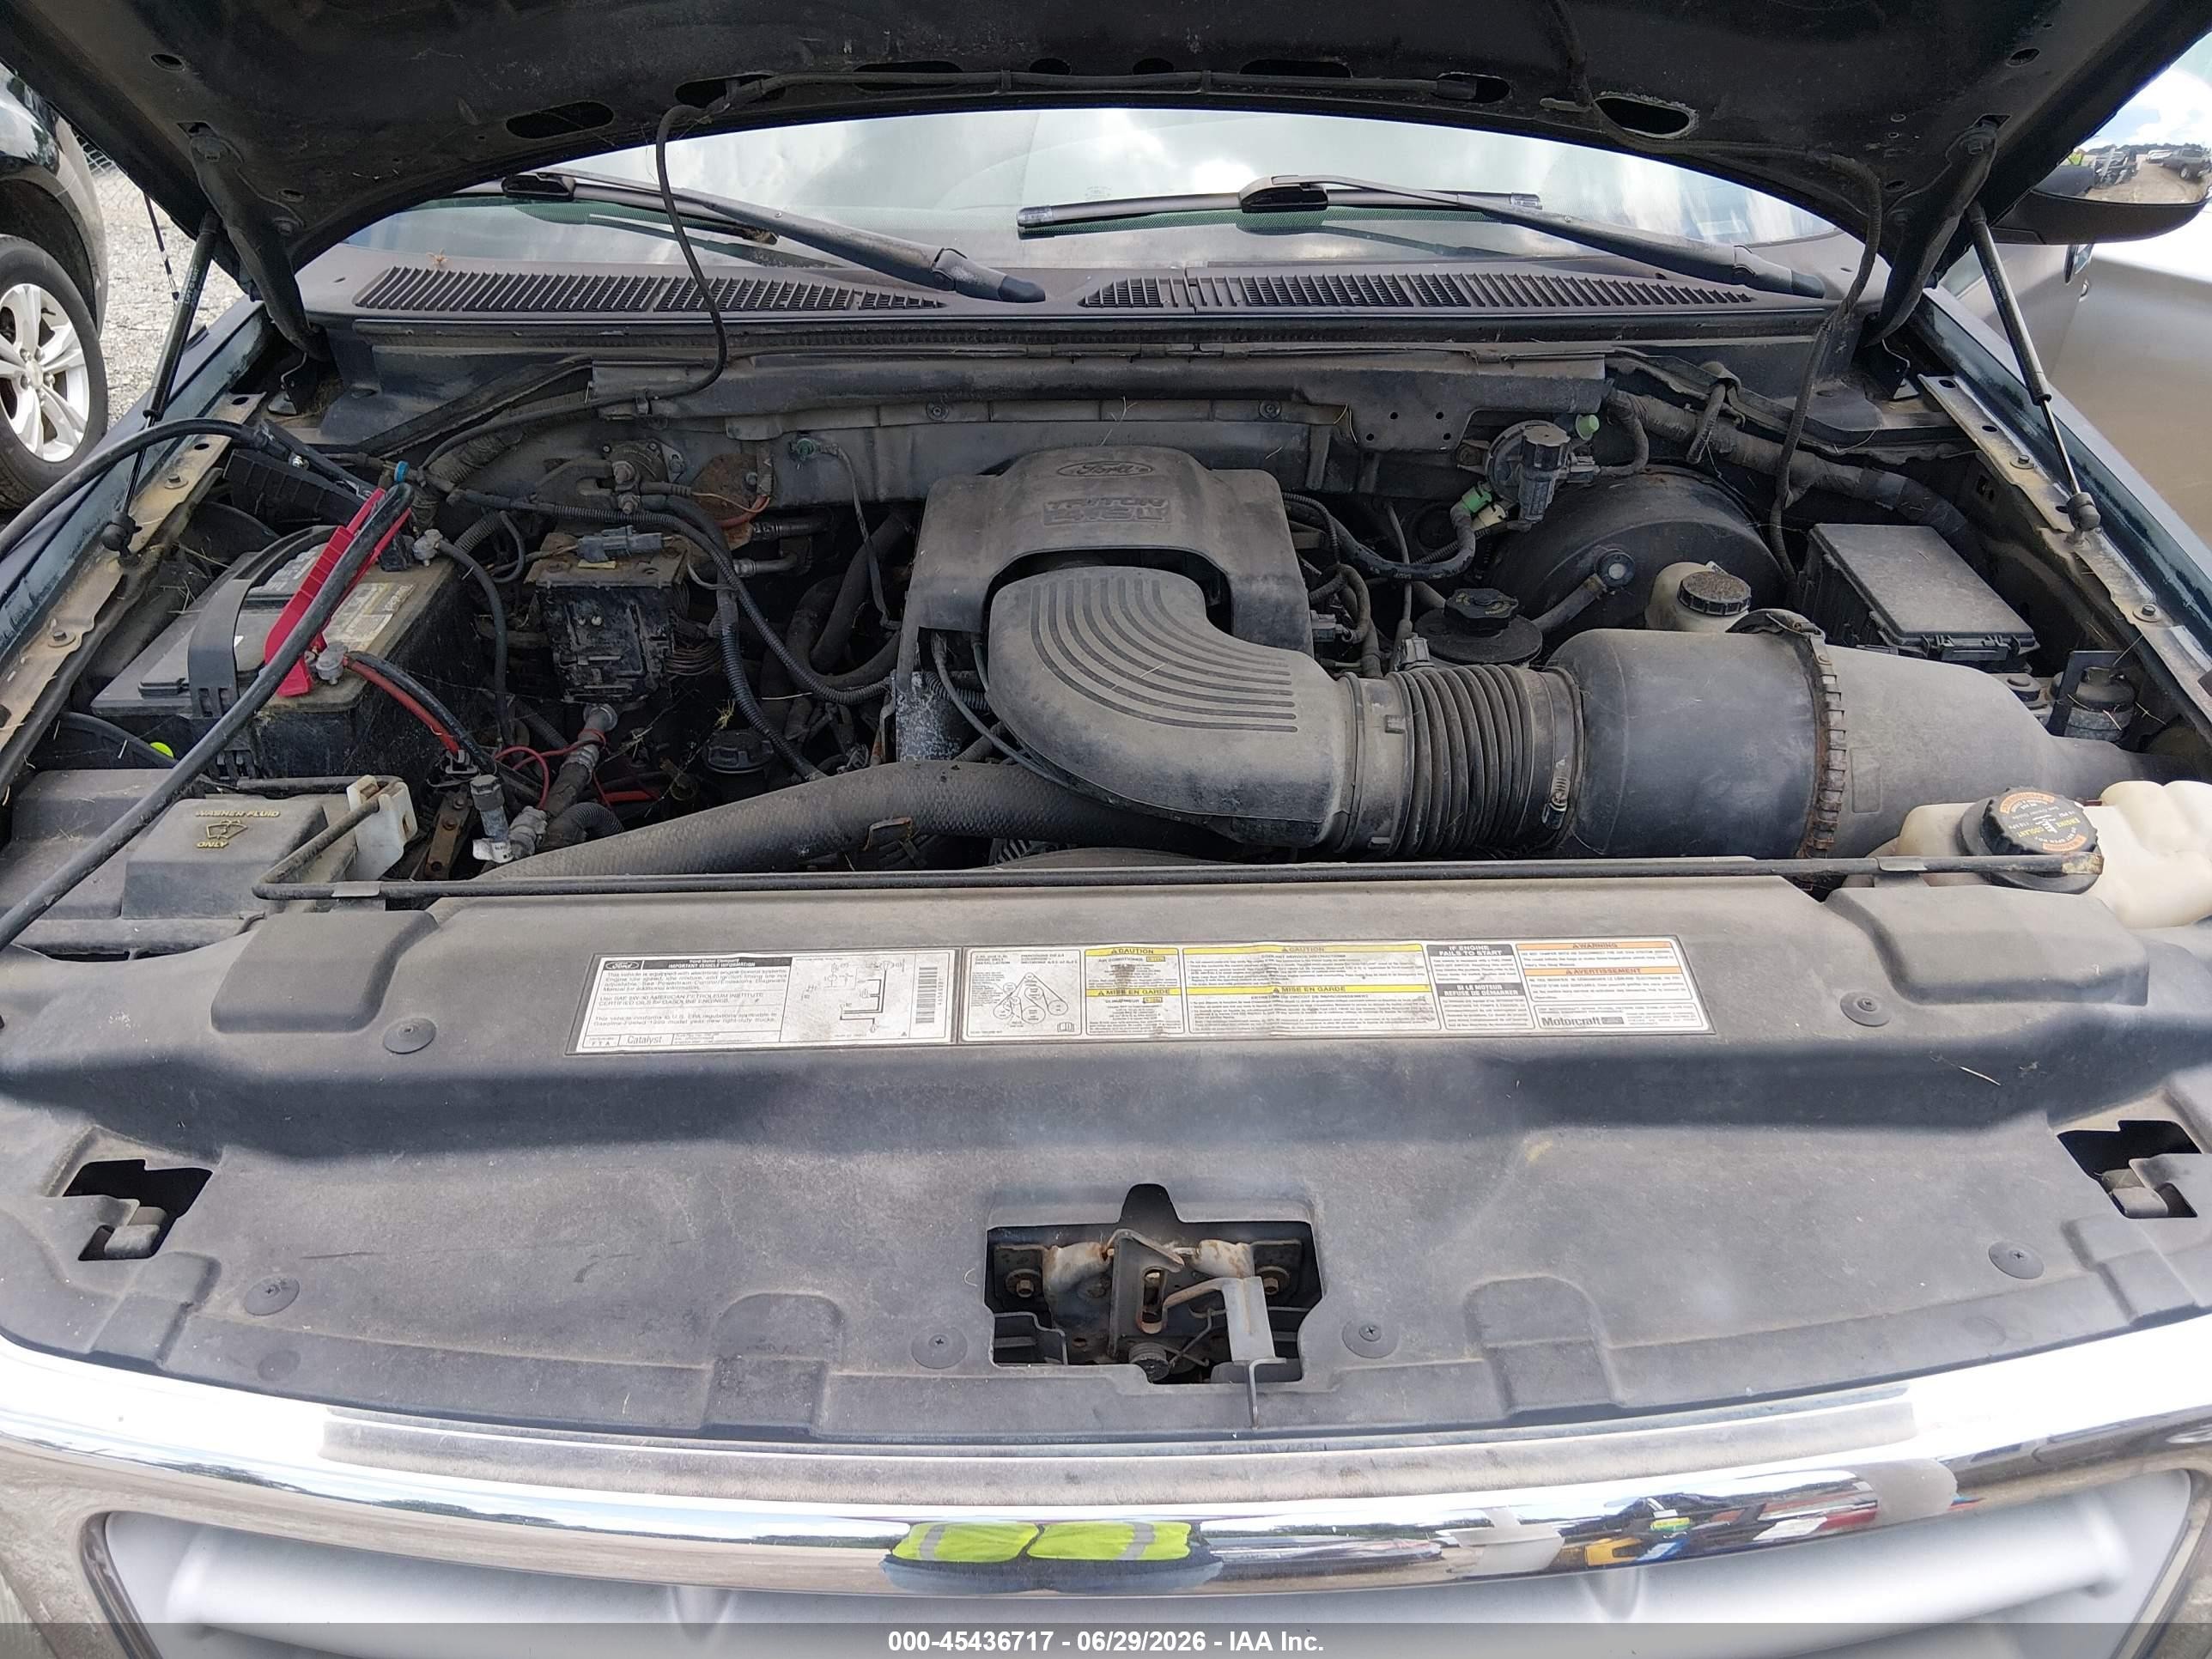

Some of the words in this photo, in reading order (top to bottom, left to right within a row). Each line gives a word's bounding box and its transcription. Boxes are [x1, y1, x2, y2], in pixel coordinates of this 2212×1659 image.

[1077, 464, 1134, 474] Ford
[2018, 826, 2045, 837] COOLANT
[1541, 1015, 1601, 1027] Motorcraft
[627, 1035, 663, 1046] Catalyst
